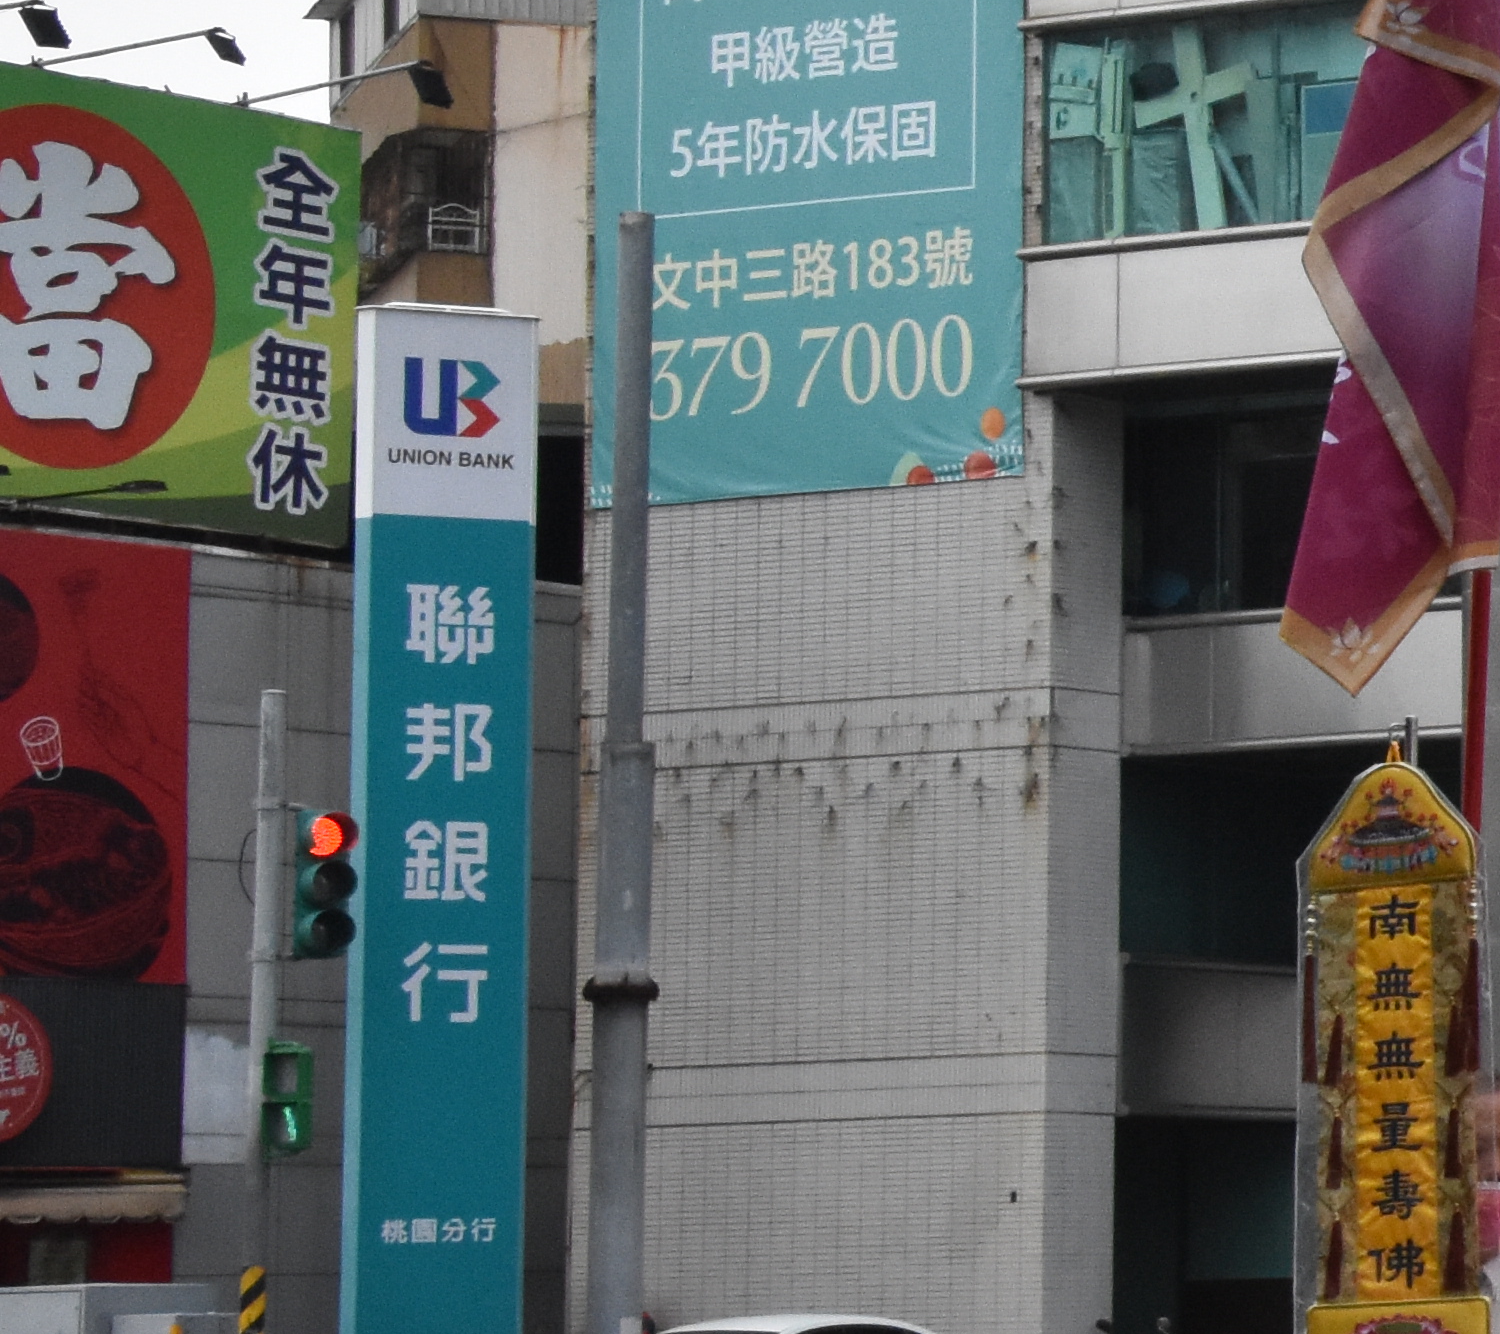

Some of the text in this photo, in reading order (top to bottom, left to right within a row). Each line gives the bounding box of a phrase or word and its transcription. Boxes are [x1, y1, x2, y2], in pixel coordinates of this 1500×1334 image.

[711, 14, 900, 88] 甲級營造
[670, 101, 936, 179] 5年防水保固
[652, 225, 974, 311] 文中三路183號
[247, 147, 340, 515] 全年無休
[650, 313, 974, 423] 379 7000
[388, 447, 514, 471] UNION BANK
[402, 584, 496, 1024] 聯邦銀行
[1367, 894, 1425, 1289] 南無無量壽佛
[381, 1217, 497, 1246] 桃園分行
